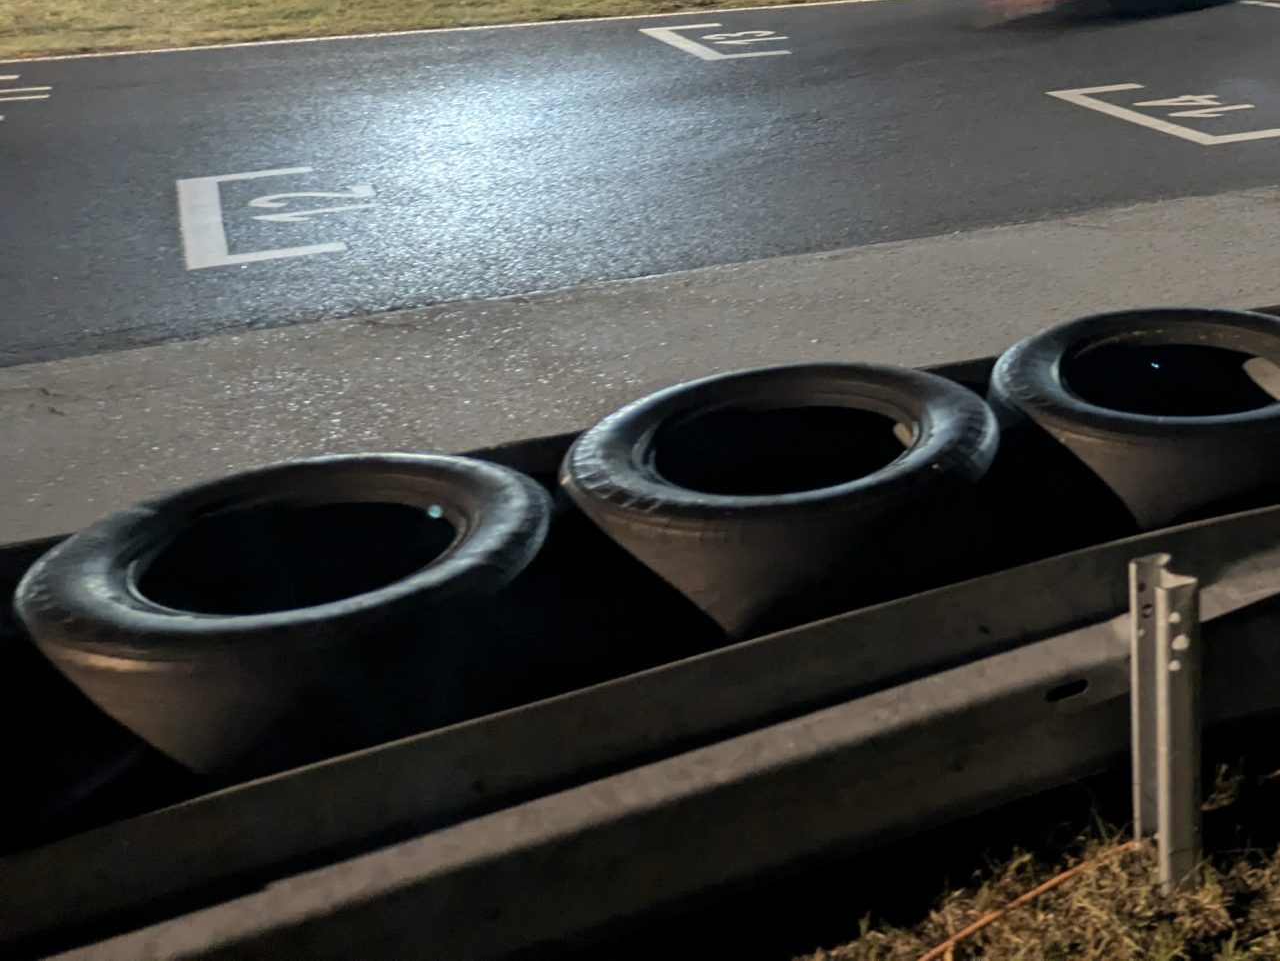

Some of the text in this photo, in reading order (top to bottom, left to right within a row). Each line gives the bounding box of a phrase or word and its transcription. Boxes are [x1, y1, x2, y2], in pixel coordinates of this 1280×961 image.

[701, 30, 789, 45] 13
[1132, 94, 1255, 118] 14
[248, 184, 383, 222] 12
